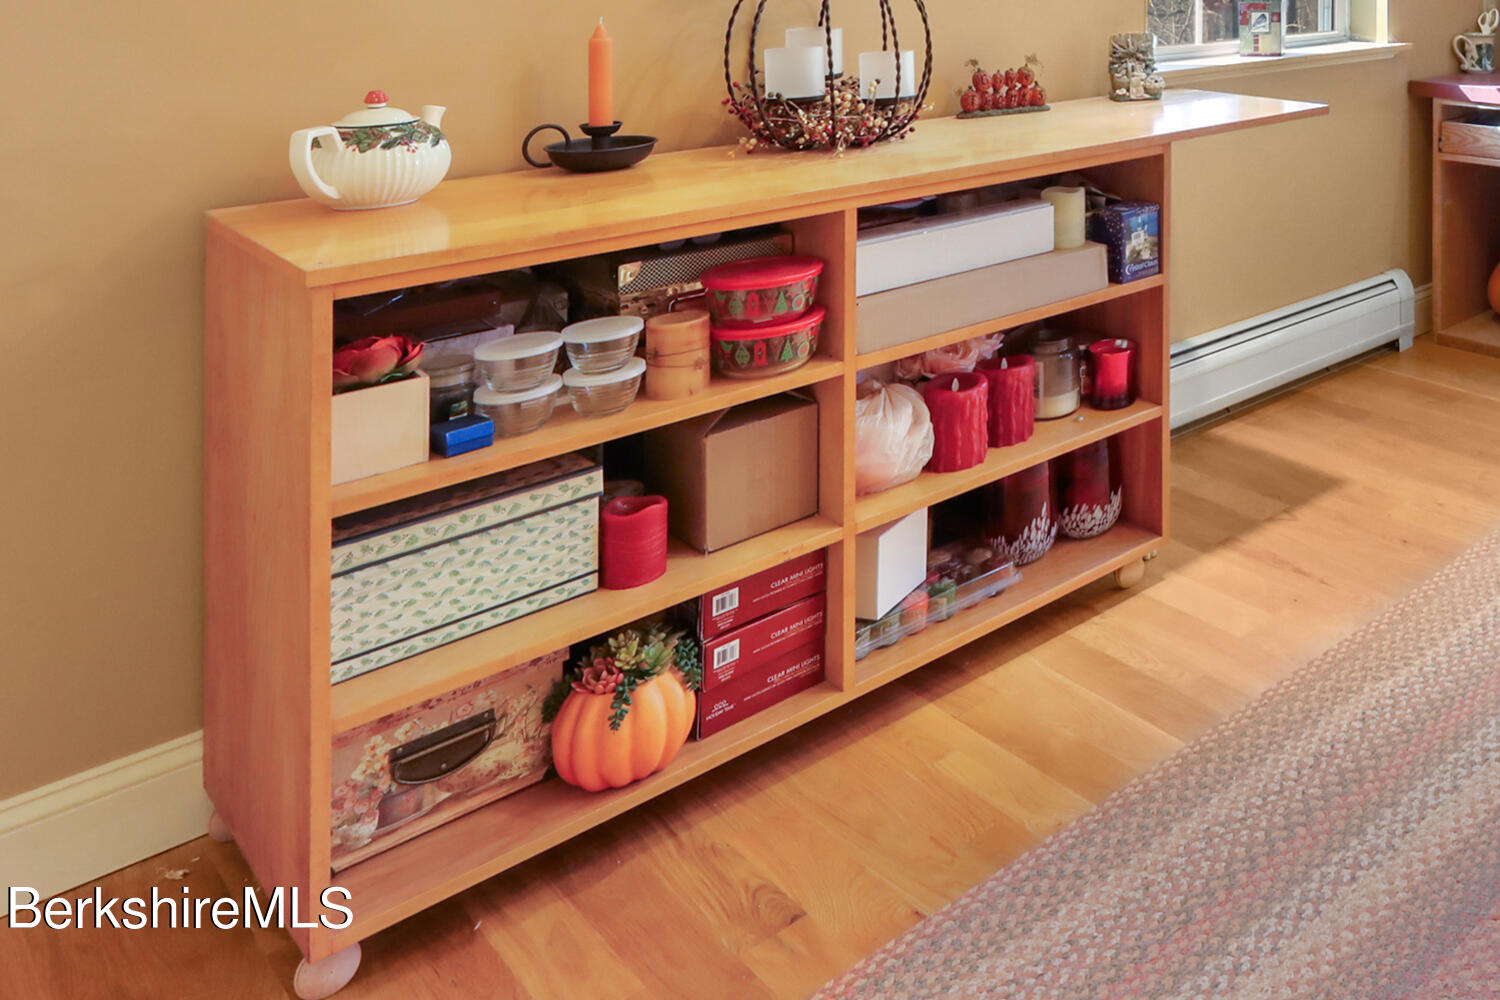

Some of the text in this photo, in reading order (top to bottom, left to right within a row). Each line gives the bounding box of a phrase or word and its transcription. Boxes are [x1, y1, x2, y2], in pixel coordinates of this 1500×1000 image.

[770, 577, 788, 588] CLEAR
[770, 627, 788, 638] CLEAR
[767, 671, 785, 683] CLEAR
